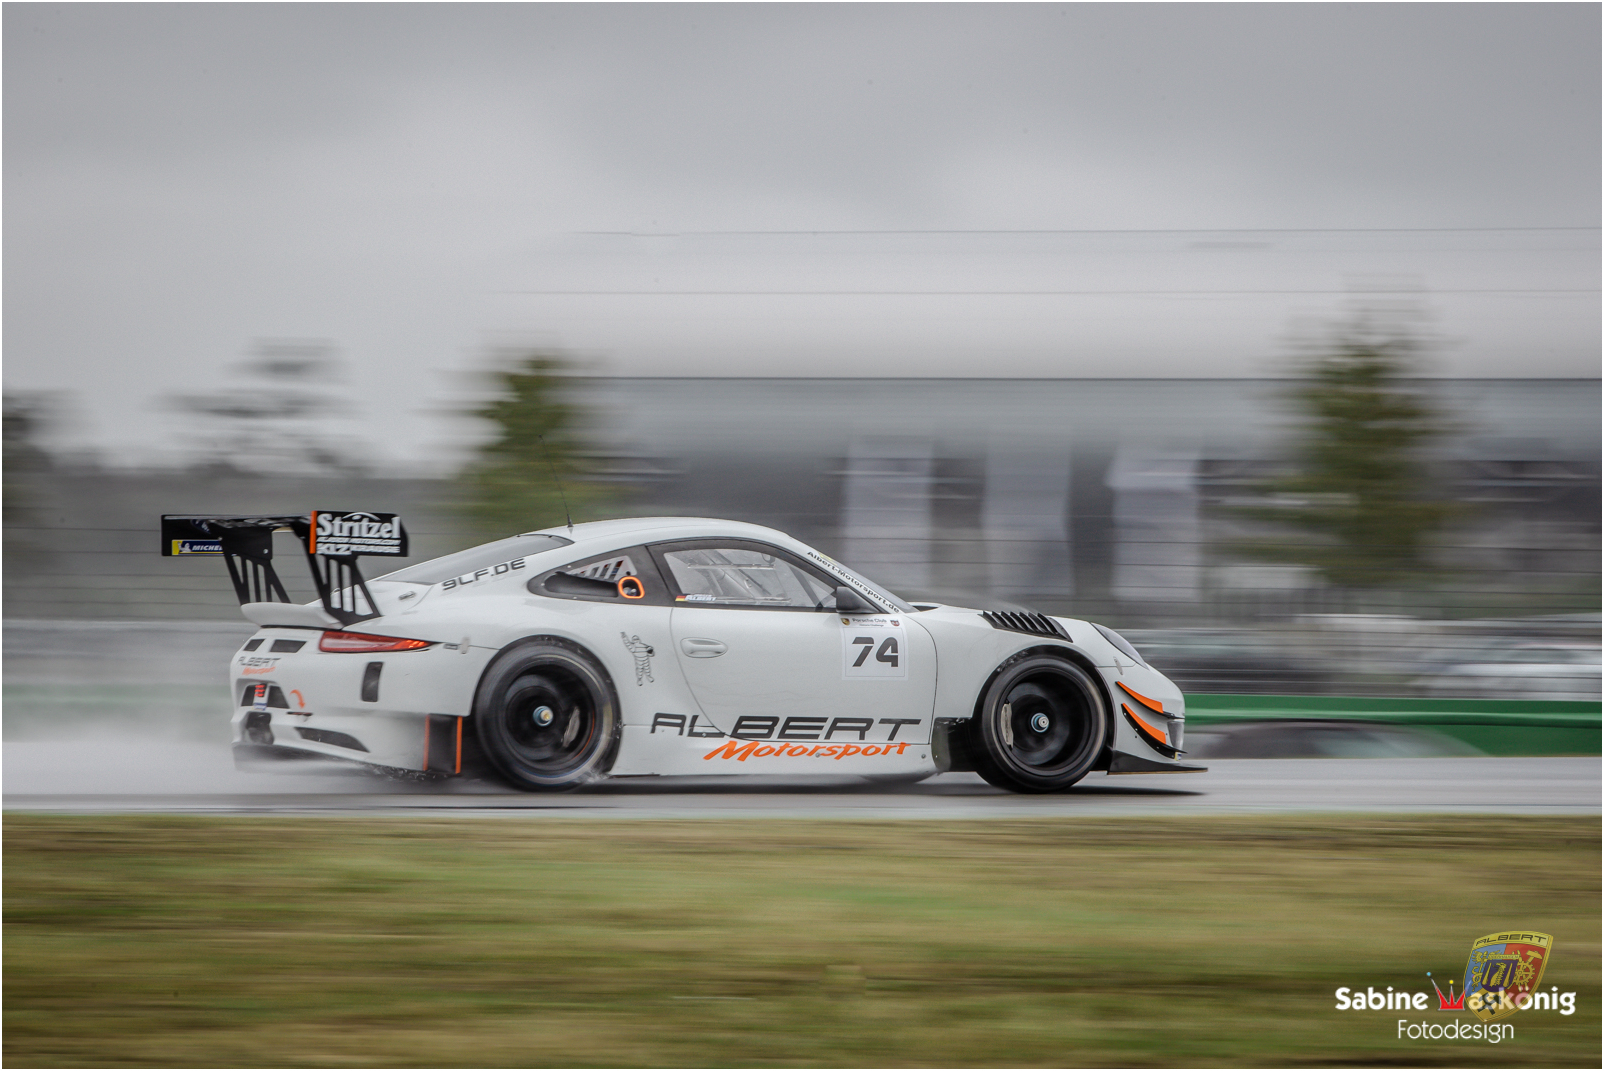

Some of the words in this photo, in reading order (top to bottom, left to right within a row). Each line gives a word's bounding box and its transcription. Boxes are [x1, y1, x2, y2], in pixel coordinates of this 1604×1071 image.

[316, 513, 401, 539] Stritzel
[442, 558, 526, 591] 9LF.DE
[807, 551, 900, 613] Albert-Motorsport.de
[237, 656, 281, 667] ALBERT
[852, 637, 898, 667] 74
[650, 712, 922, 741] ALBERT
[703, 740, 912, 762] Motorsport
